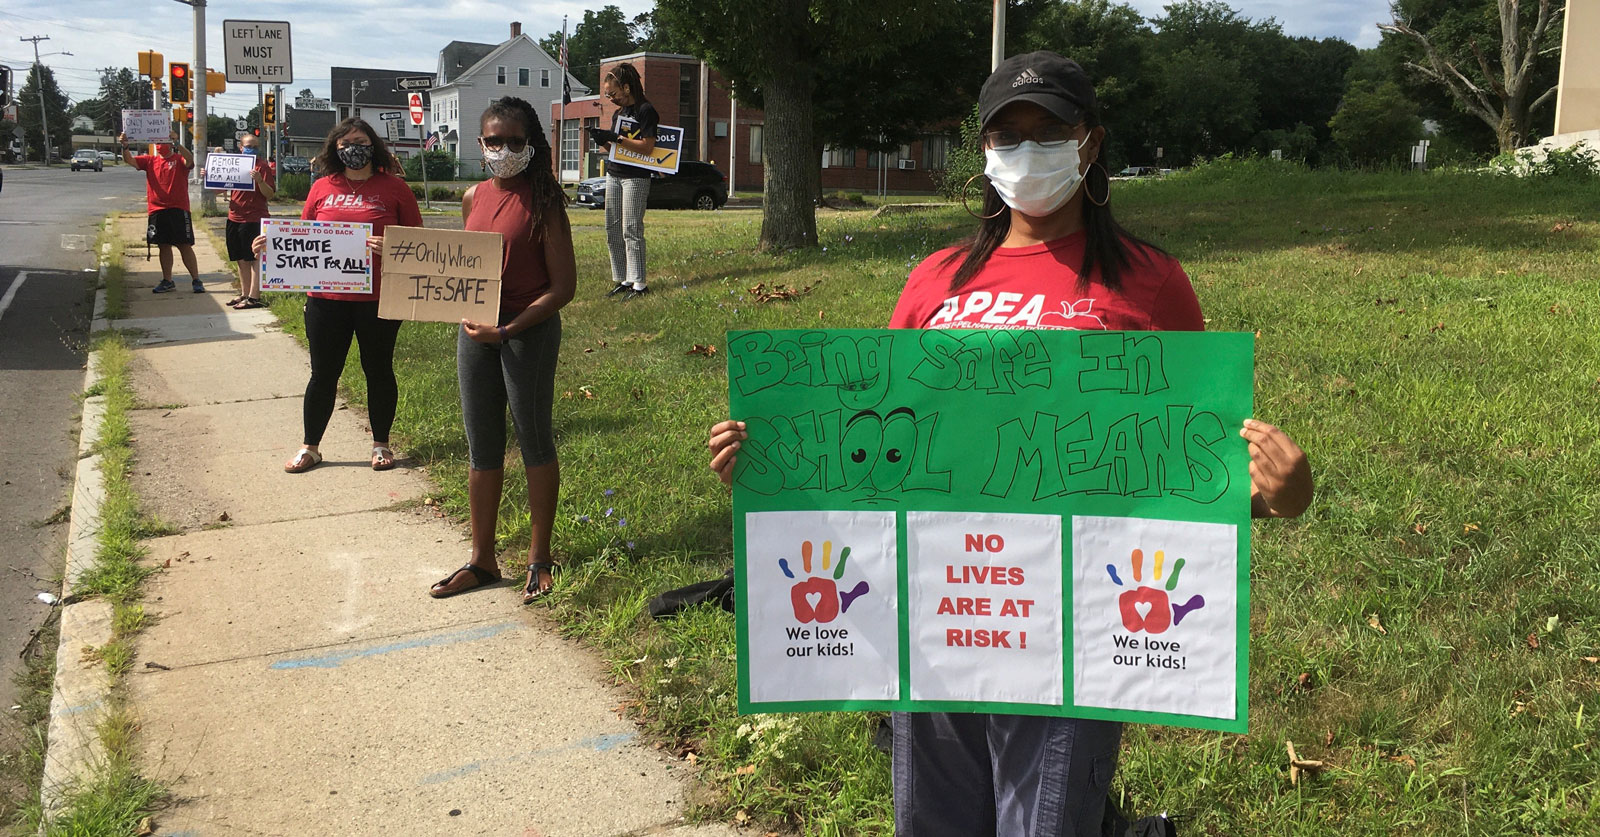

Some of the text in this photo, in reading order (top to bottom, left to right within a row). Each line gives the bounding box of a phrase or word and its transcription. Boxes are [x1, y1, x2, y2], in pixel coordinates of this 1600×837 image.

[232, 29, 282, 39] LEFT LANE
[243, 46, 272, 58] MUST
[234, 65, 284, 76] TURN LEFT
[1012, 76, 1044, 88] adidas
[126, 117, 142, 128] ONLY
[211, 156, 240, 166] REMOTE
[617, 147, 656, 163] STAFFING
[210, 166, 240, 174] RETURN
[210, 173, 223, 181] FOR
[324, 193, 363, 206] APEA
[272, 237, 331, 253] REMOTE
[276, 254, 319, 269] START
[342, 257, 367, 271] ALL
[389, 240, 482, 274] #OnlyWhen
[930, 291, 1045, 325] APEA
[728, 330, 1169, 411] Being Safe In
[736, 405, 1230, 504] SCHOOL MEANS
[965, 533, 1004, 553] NO
[946, 565, 1024, 585] LIVES
[937, 596, 1034, 617] ARE AT
[786, 626, 848, 640] We love
[946, 628, 1011, 648] RISK
[786, 642, 854, 657] our kids!
[1112, 634, 1180, 652] We love
[1113, 653, 1186, 670] our kids!
